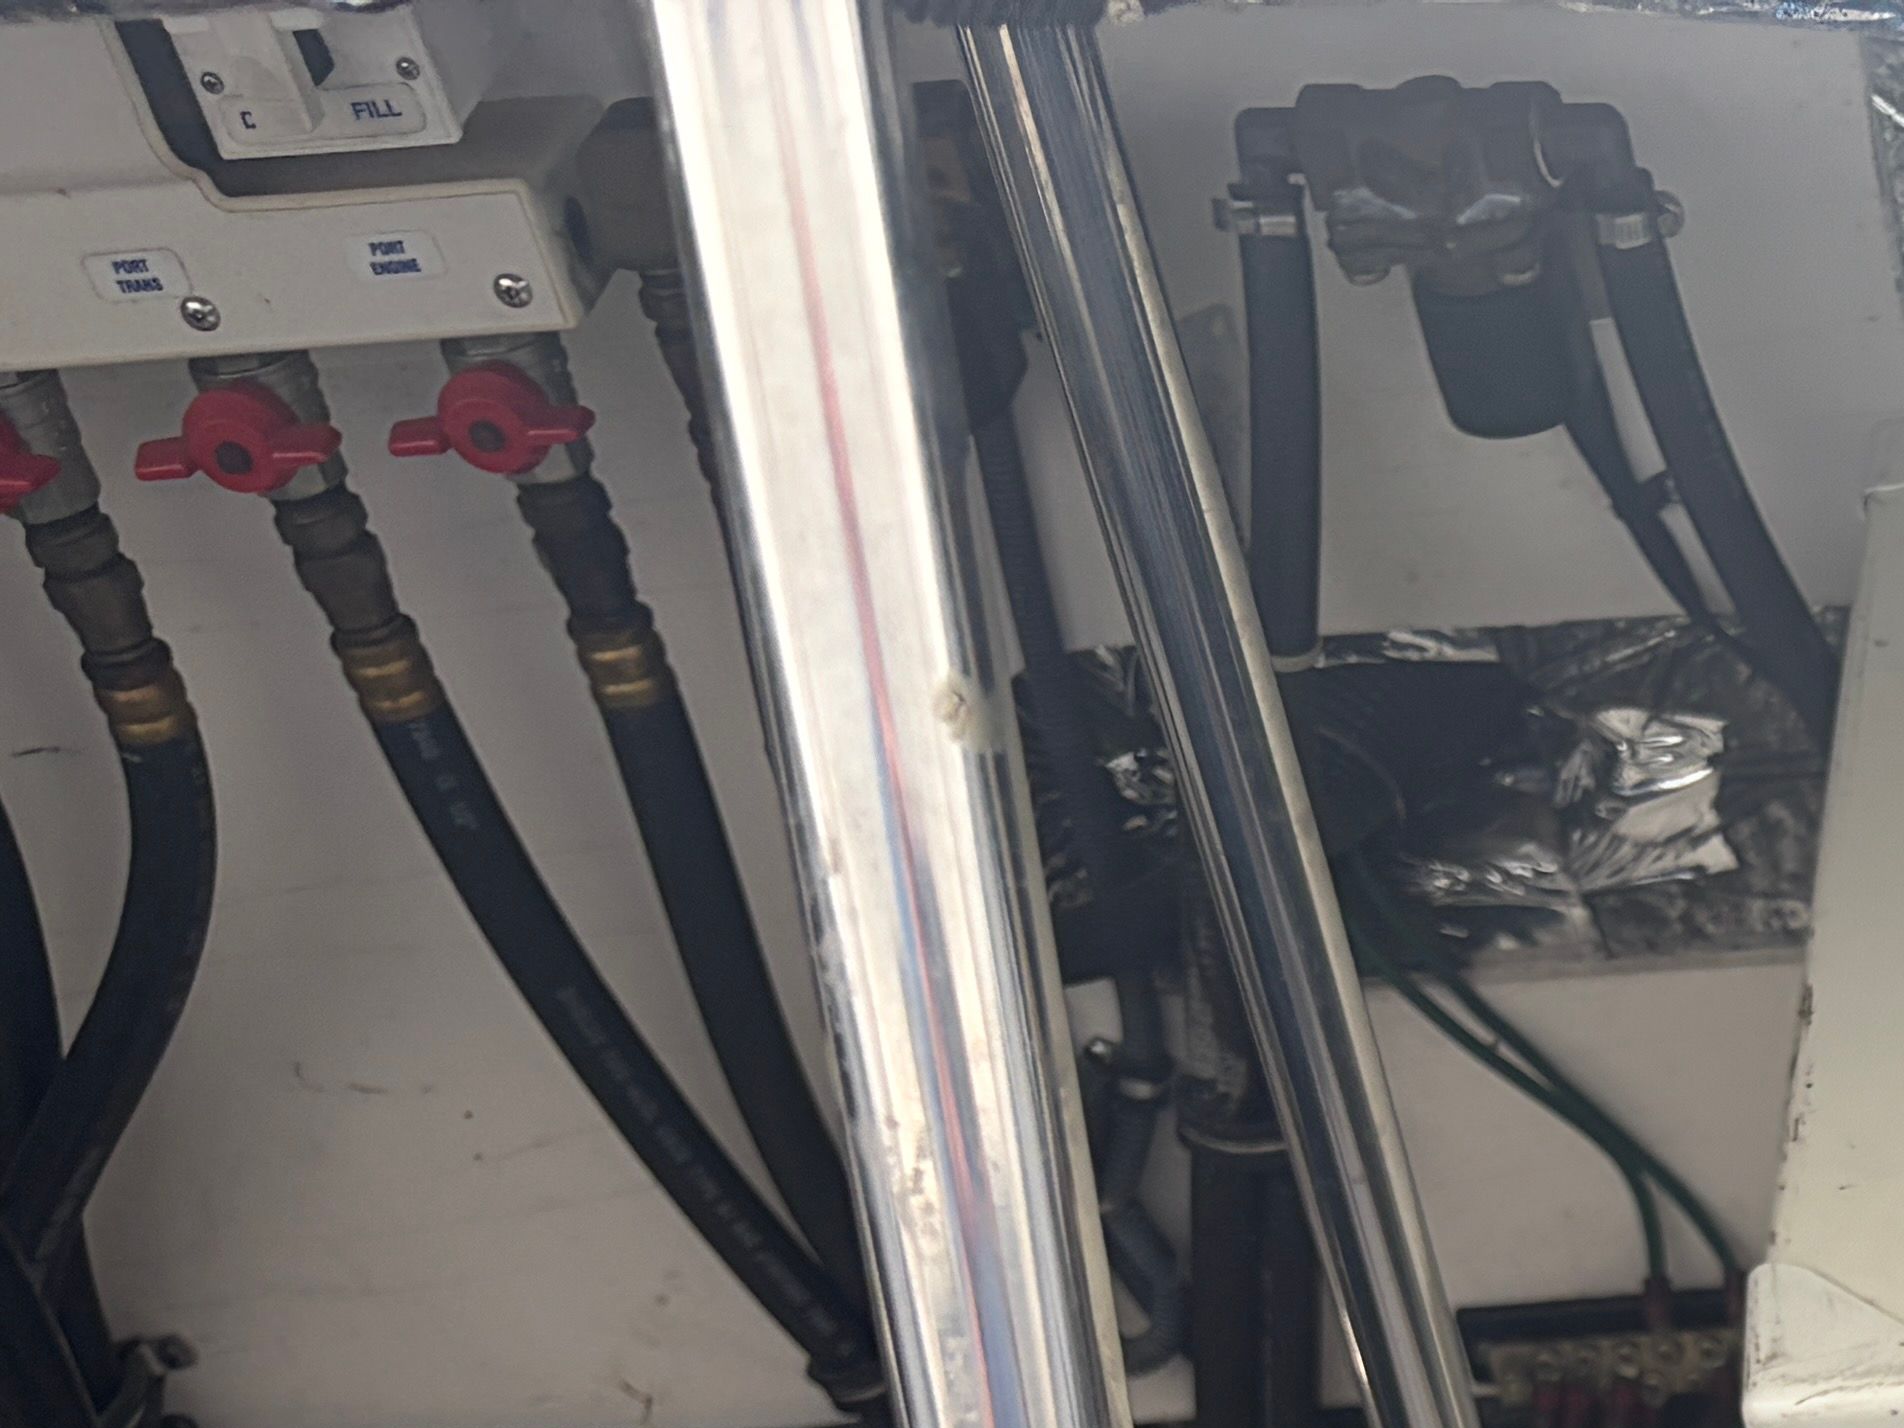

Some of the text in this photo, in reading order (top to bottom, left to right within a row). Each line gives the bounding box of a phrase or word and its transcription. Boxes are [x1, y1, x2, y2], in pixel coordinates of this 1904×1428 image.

[351, 99, 402, 121] FILL
[368, 240, 406, 256] PORT
[112, 258, 149, 275] PORT
[369, 258, 422, 276] ENGINE
